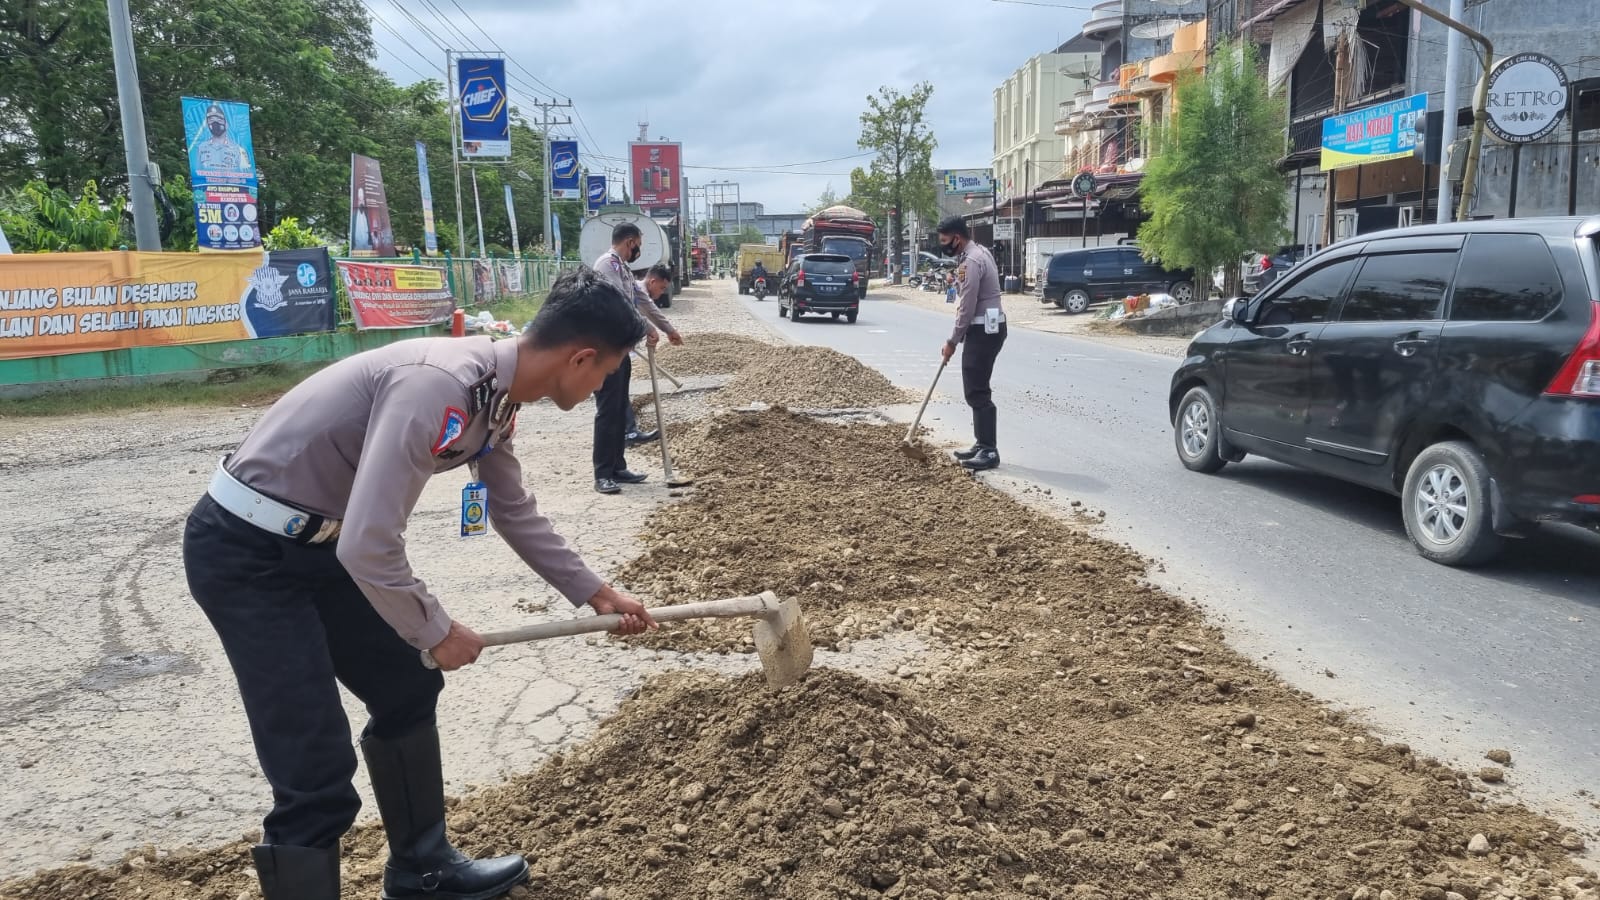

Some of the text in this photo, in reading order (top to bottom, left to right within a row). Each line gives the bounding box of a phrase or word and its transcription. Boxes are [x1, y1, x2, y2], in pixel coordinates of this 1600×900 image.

[463, 87, 497, 107] CHIEF
[1487, 90, 1563, 107] RETRO
[554, 158, 573, 169] CHIEF
[199, 209, 222, 223] 5M
[62, 285, 118, 307] BULAN
[121, 282, 197, 305] DESEMBER
[38, 314, 76, 336] DAN
[79, 311, 139, 334] SELALU
[142, 308, 182, 329] PAKAI
[185, 303, 240, 326] MASKER
